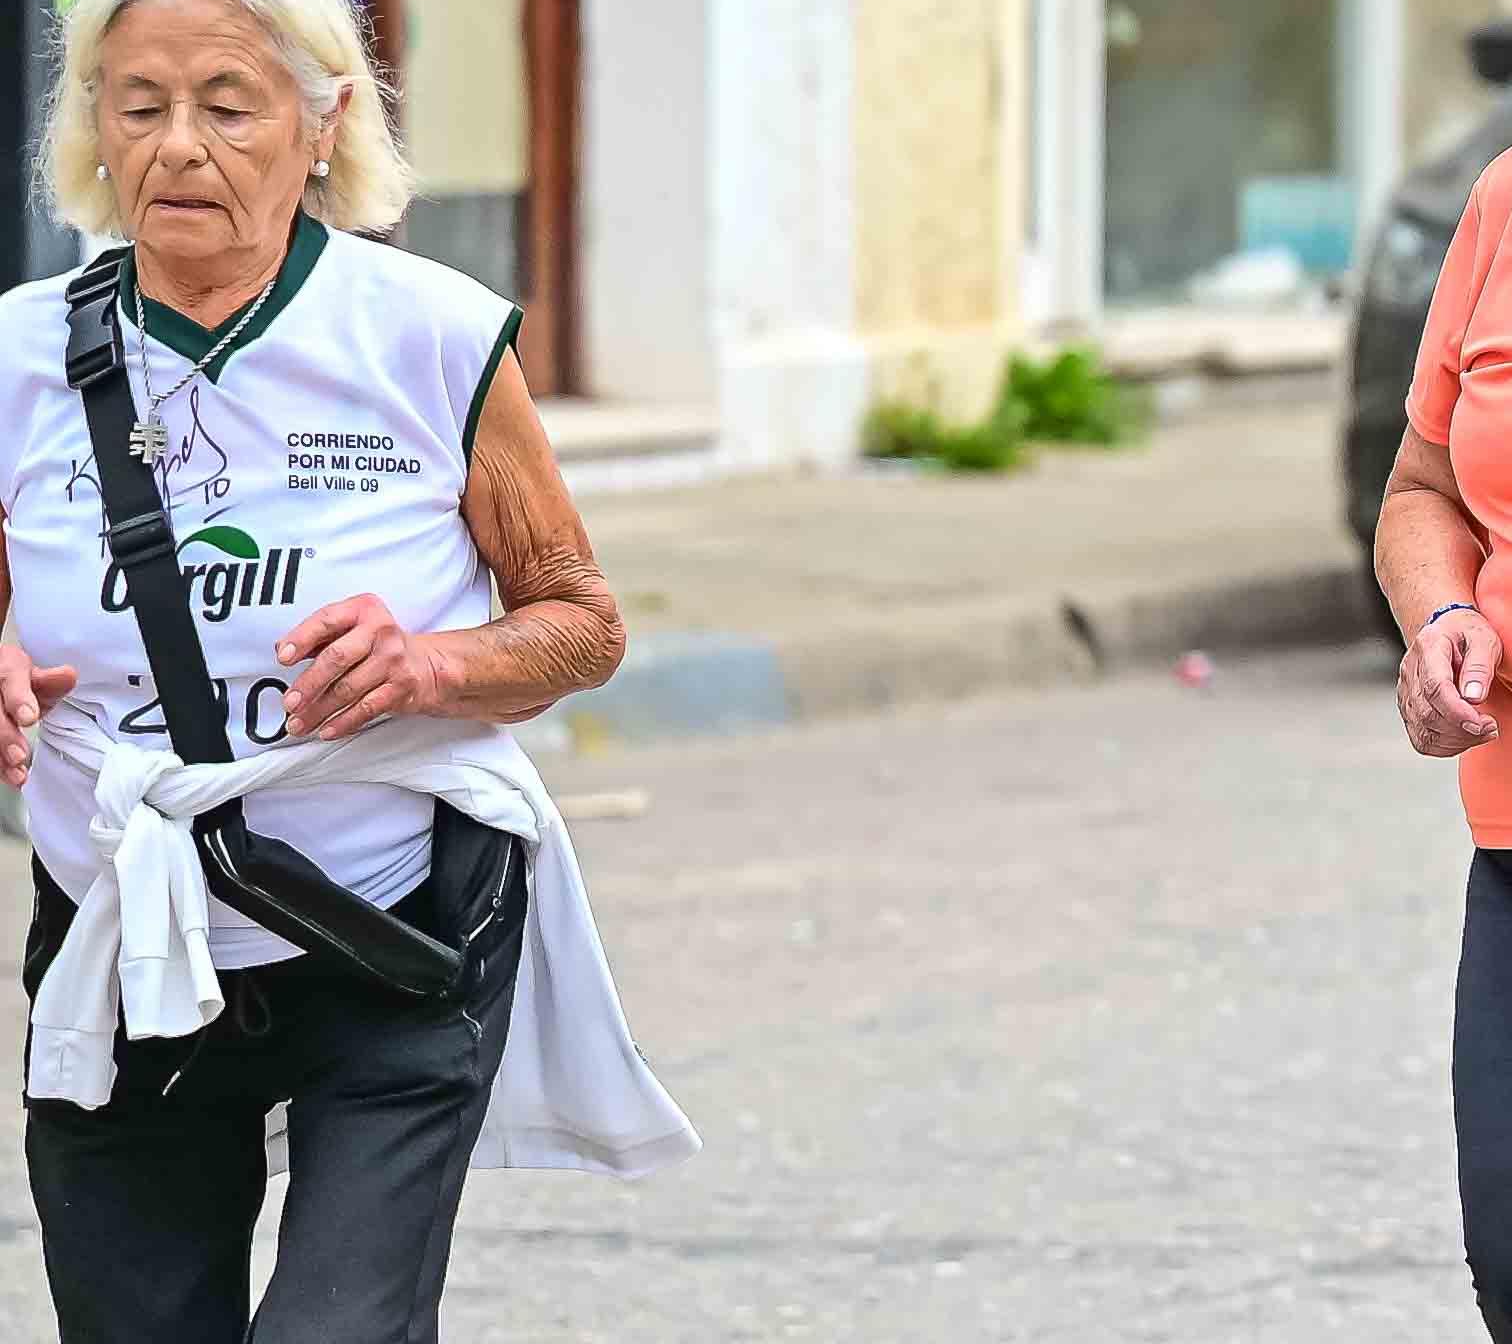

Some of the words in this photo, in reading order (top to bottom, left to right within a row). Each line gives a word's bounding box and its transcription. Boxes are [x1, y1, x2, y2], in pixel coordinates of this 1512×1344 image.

[287, 433, 394, 450] CORRIENDO
[288, 454, 325, 469] POR
[331, 456, 350, 470] MI
[354, 456, 421, 474] CIUDAD
[288, 475, 318, 490] Bell
[323, 476, 356, 491] Ville
[360, 478, 379, 493] 09
[101, 546, 304, 623] Crgill
